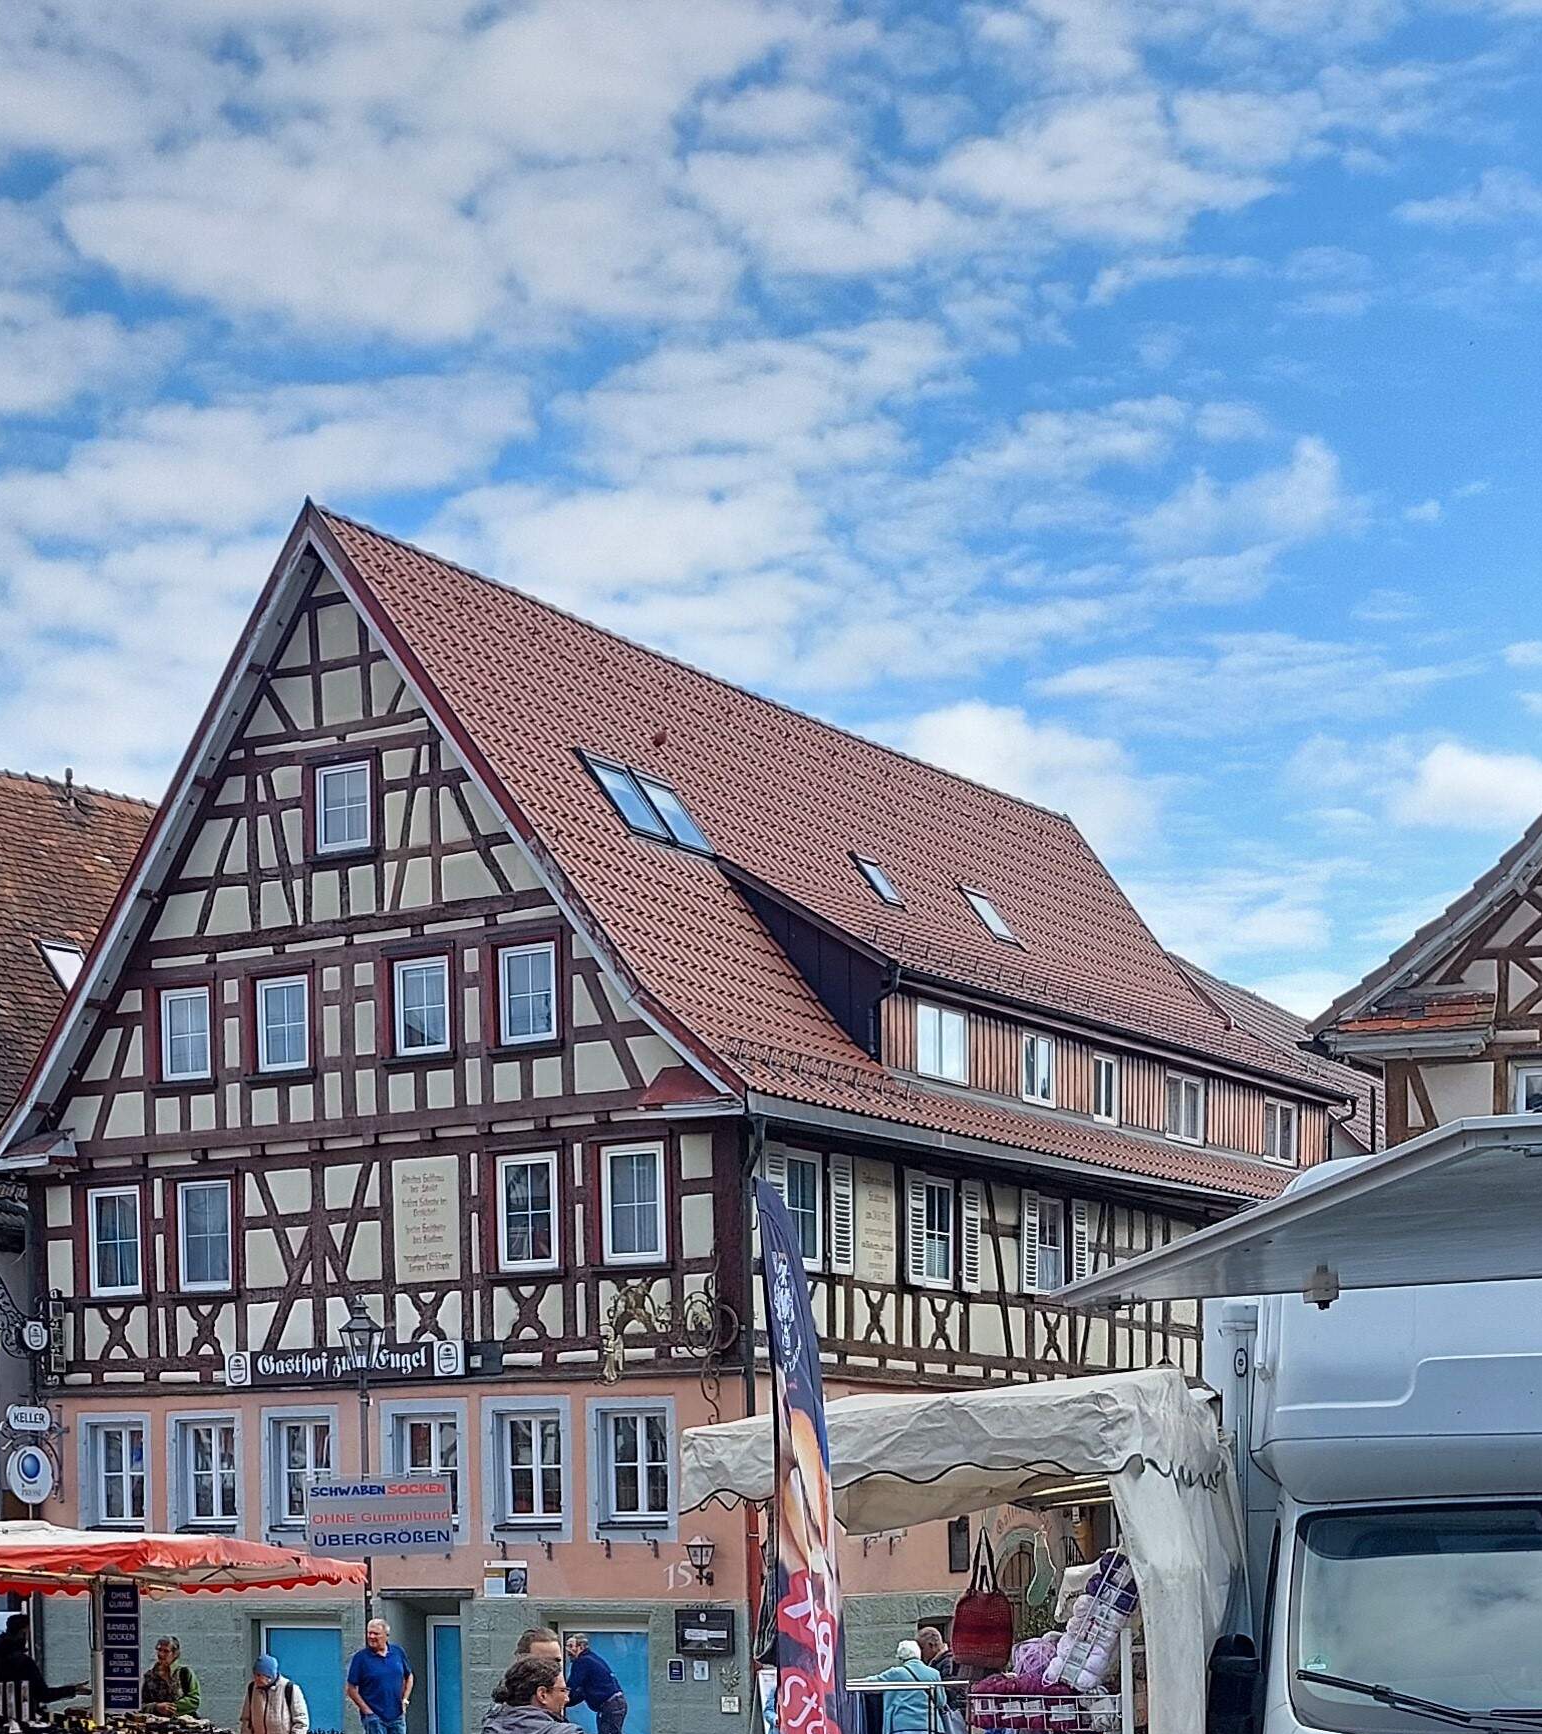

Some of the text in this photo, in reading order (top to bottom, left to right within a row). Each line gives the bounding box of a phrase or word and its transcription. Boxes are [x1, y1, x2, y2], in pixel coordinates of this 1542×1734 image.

[257, 1346, 428, 1378] Gasthof zum Engel
[13, 1411, 45, 1424] KELLER
[310, 1483, 446, 1497] SCHWABEN SOCKEN
[312, 1509, 450, 1524] OHNE Gummibund
